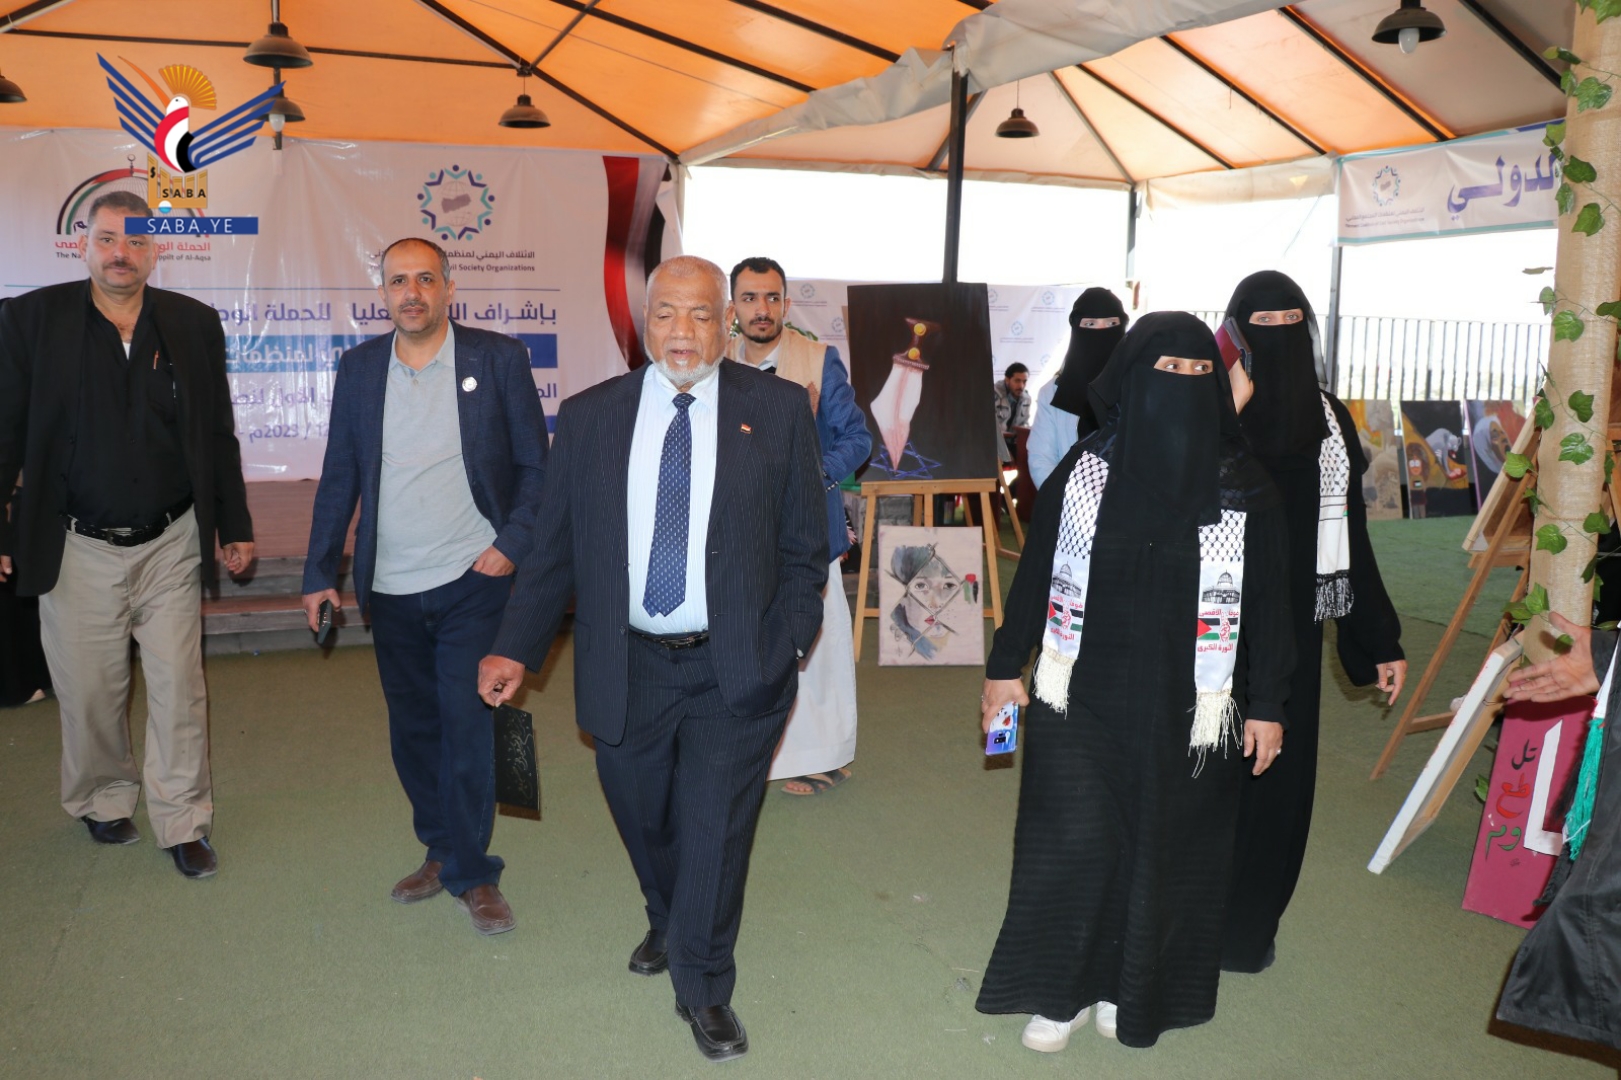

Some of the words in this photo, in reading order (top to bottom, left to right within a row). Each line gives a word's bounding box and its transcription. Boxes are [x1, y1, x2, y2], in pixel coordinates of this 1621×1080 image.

[1447, 154, 1557, 221] لدولي
[177, 242, 210, 251] الحملة
[445, 250, 475, 258] لمنظما
[476, 251, 504, 261] اليمني
[458, 264, 485, 272] Society
[486, 264, 535, 272] Organizations
[264, 302, 331, 321] للحملة
[352, 303, 391, 325] عليا
[474, 301, 556, 325] بإشراف
